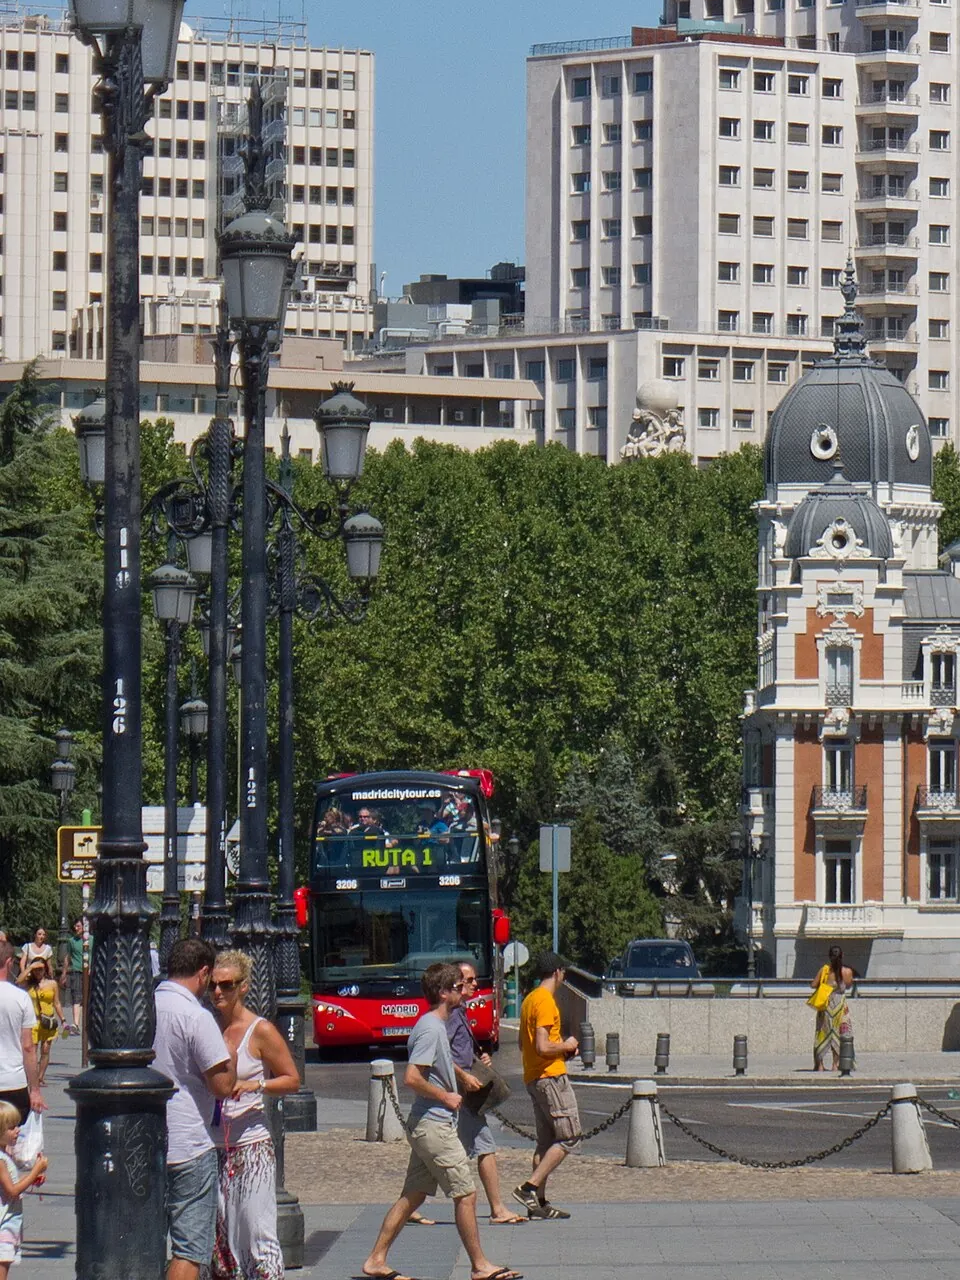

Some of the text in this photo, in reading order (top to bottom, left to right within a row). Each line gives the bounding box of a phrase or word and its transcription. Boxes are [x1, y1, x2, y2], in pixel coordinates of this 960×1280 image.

[112, 678, 126, 734] 126
[352, 789, 441, 800] madridcitytour.es
[362, 848, 432, 867] RUTA 1
[336, 879, 358, 890] 3206
[438, 875, 460, 886] 3206
[382, 1005, 418, 1014] MADRID
